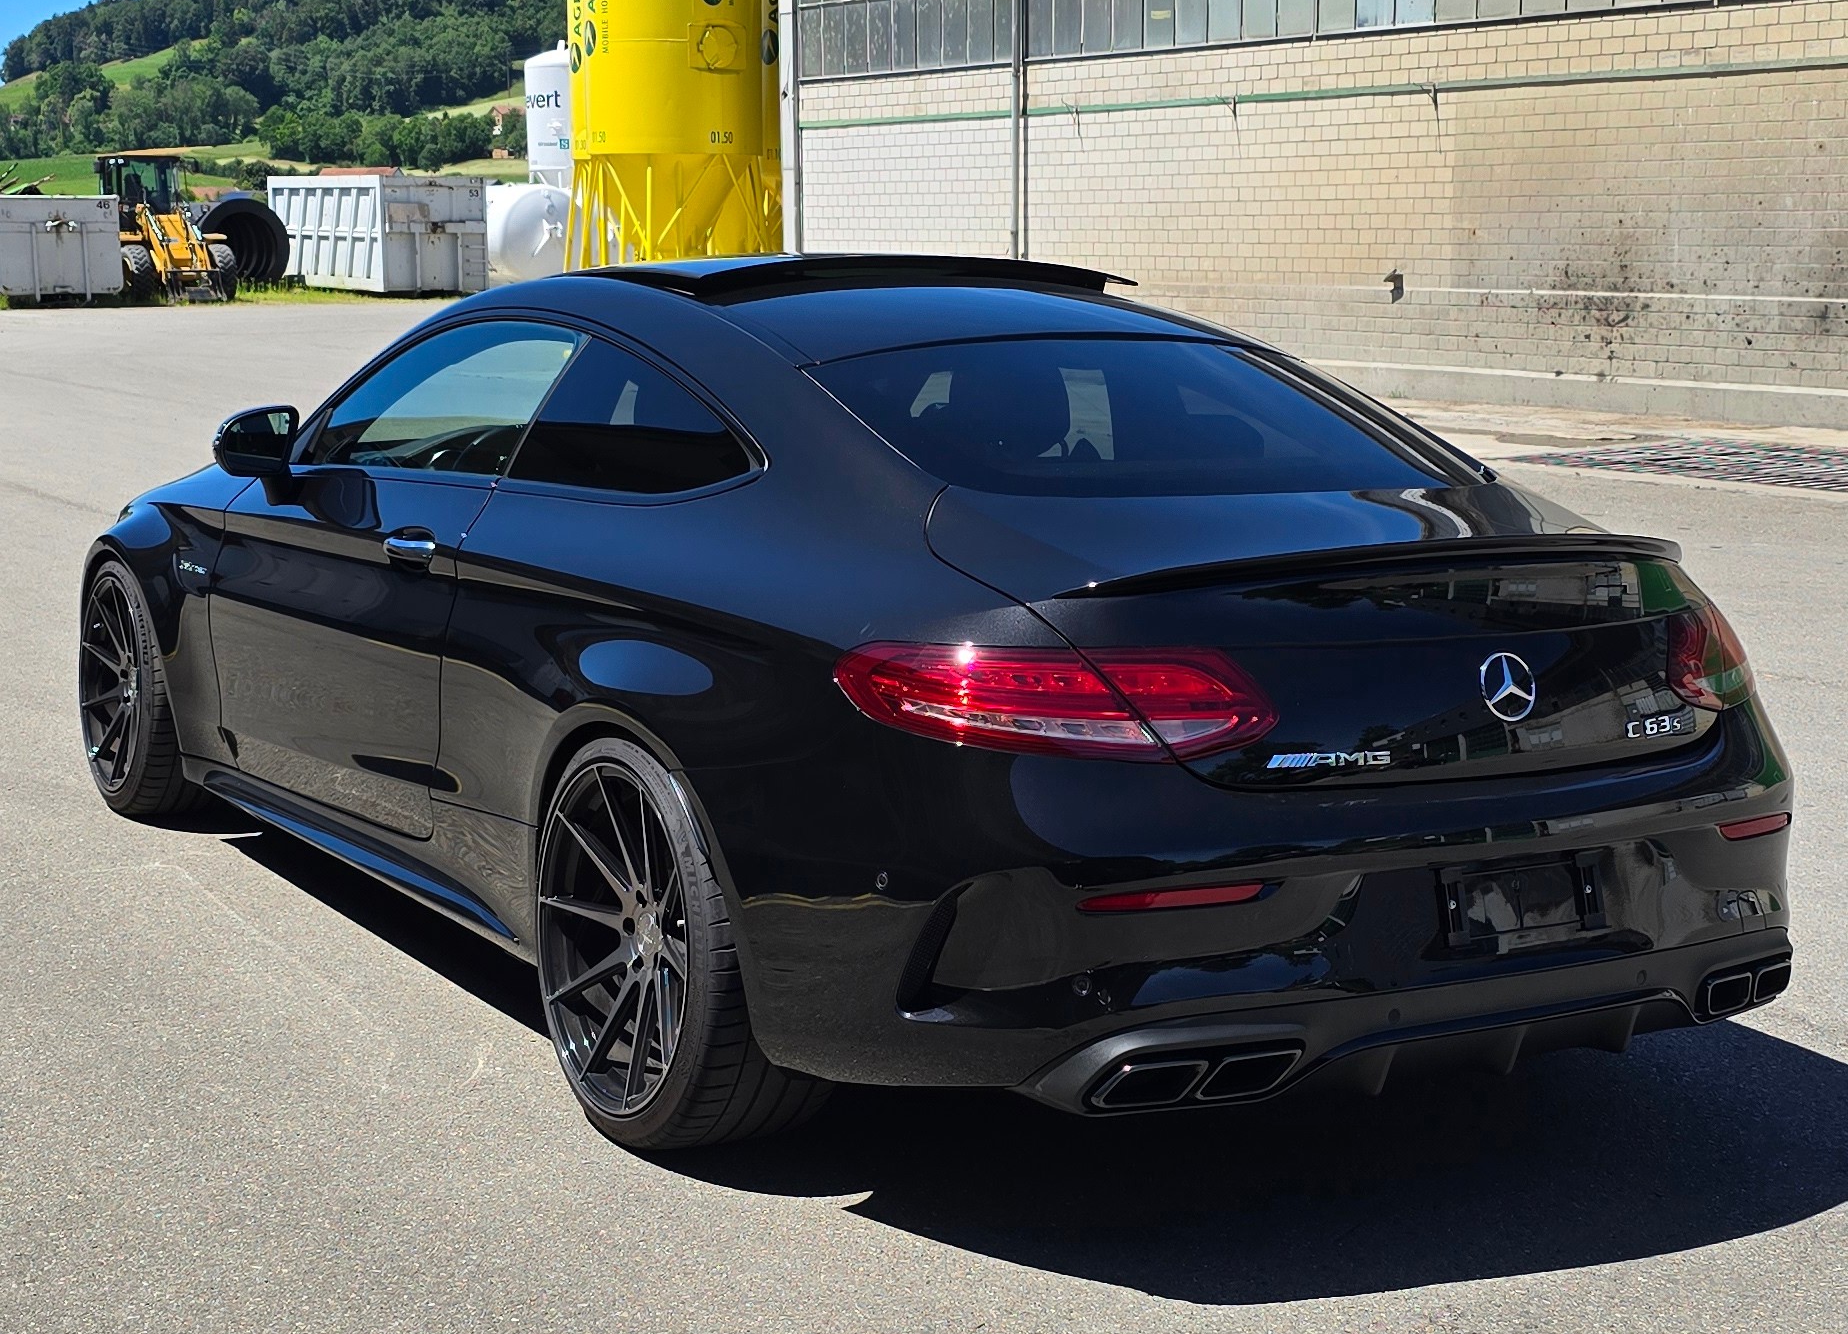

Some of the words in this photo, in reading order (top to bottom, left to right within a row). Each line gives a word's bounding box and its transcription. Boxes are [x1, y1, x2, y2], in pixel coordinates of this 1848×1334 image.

[710, 131, 733, 144] 01.50
[469, 189, 479, 198] 53
[96, 200, 110, 209] 46
[1626, 721, 1641, 738] C
[684, 856, 703, 971] MICHELIN
